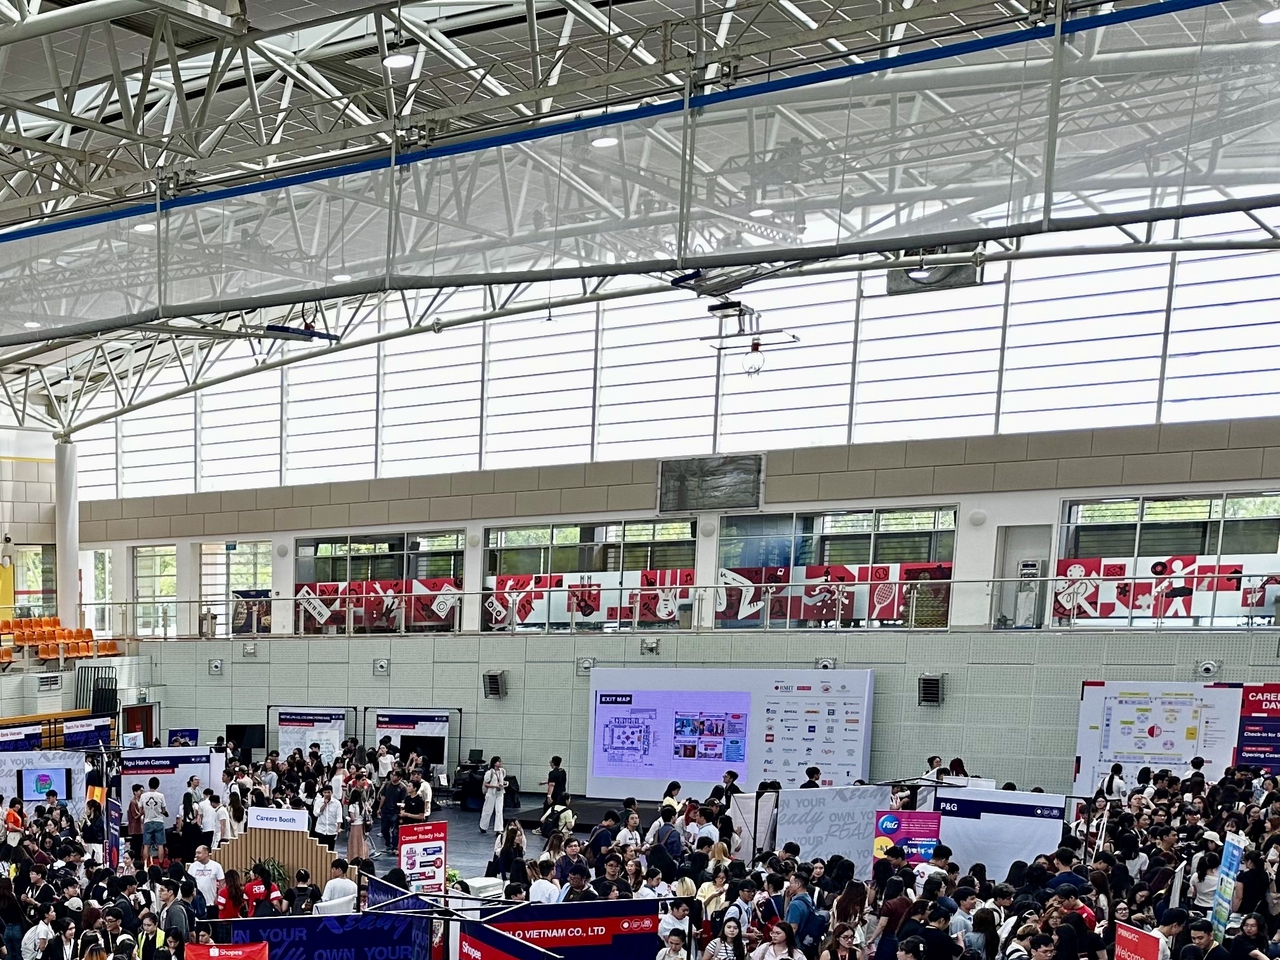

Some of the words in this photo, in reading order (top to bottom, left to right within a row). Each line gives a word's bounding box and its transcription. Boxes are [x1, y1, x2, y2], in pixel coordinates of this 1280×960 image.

[940, 802, 958, 811] P&G
[256, 814, 276, 823] Careers
[278, 815, 296, 823] Booth
[883, 821, 898, 829] P&G
[525, 928, 566, 938] VIETNAM
[567, 927, 586, 938] CO.,
[588, 926, 606, 936] LTD
[220, 948, 242, 957] Shopee
[367, 945, 412, 960] YOUR
[462, 941, 481, 960] Shopee
